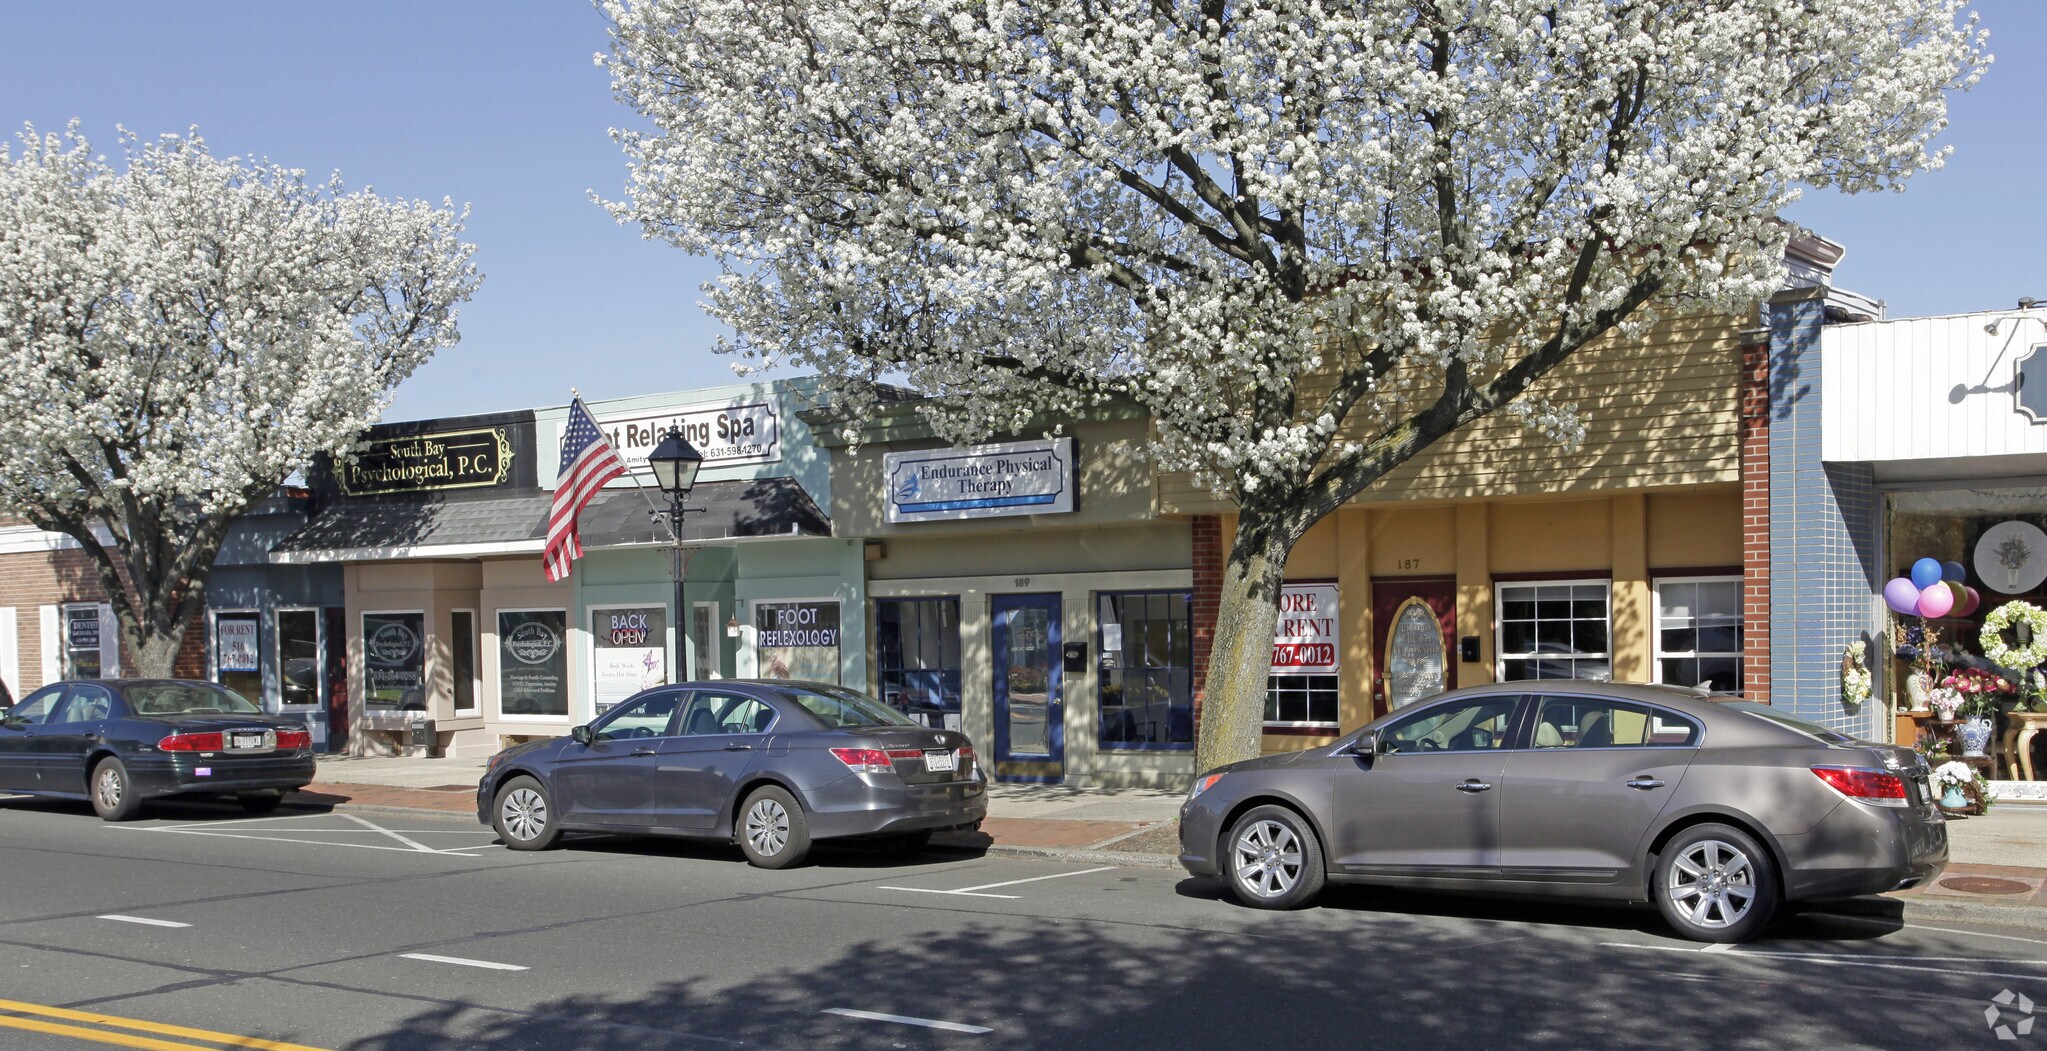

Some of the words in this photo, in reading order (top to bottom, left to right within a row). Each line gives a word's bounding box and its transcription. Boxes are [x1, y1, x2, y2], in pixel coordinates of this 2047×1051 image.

[627, 418, 710, 448] Relaing
[717, 413, 754, 444] Spa
[390, 441, 422, 459] South
[424, 440, 445, 458] Bay
[626, 456, 647, 464] Amity
[921, 463, 992, 480] Endurance
[996, 456, 1052, 477] Physical
[352, 457, 454, 488] Psychological,
[458, 454, 493, 476] P.C.
[957, 479, 1014, 496] Therapy
[1397, 559, 1420, 570] 187
[1014, 578, 1031, 588] 189
[1280, 593, 1317, 612] ORE
[611, 614, 648, 629] BACK
[778, 608, 818, 625] FOOT
[220, 625, 235, 636] FOR
[236, 624, 254, 636] RENT
[517, 626, 535, 639] South
[536, 627, 548, 640] Bay
[1284, 618, 1334, 637] RENT
[232, 641, 245, 651] 516
[612, 630, 646, 645] OPEN
[760, 629, 837, 646] REFLEXOLOGY
